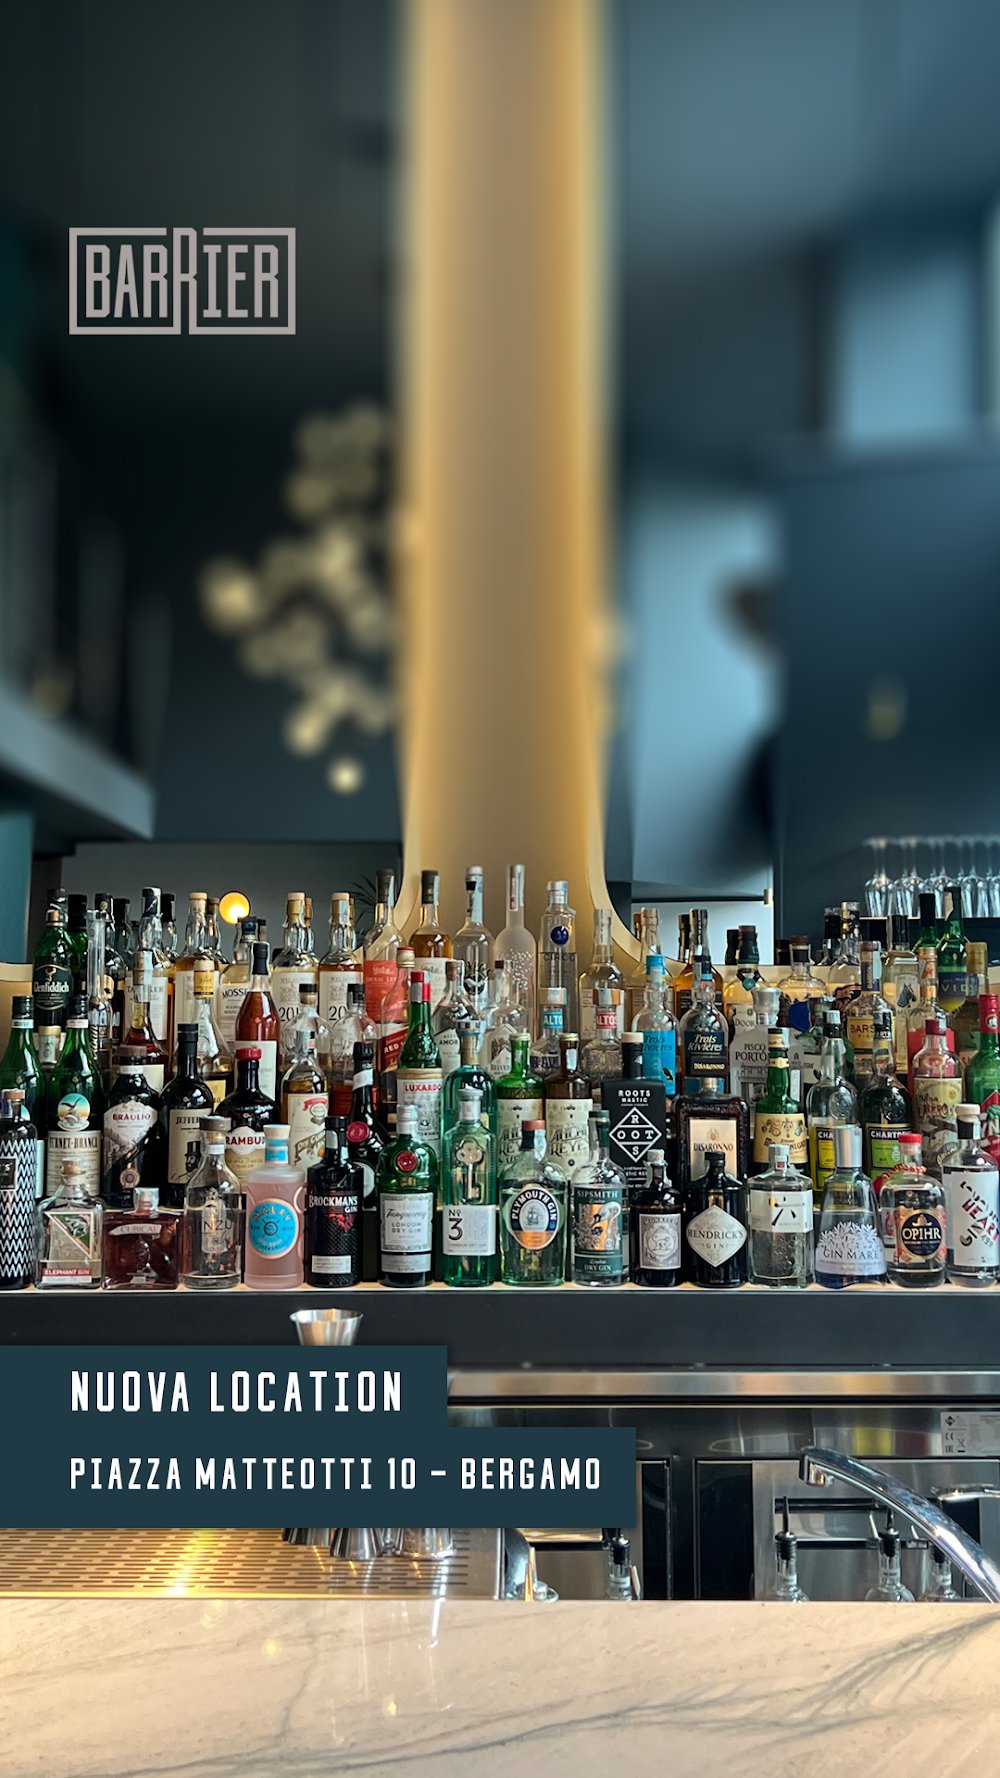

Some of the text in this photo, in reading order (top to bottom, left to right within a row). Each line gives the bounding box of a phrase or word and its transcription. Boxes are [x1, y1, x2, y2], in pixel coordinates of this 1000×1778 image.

[694, 1034, 717, 1044] Trois
[743, 1043, 766, 1051] PISCO
[693, 1062, 725, 1070] DISARONNO
[404, 1083, 443, 1092] LUXARDO
[617, 1089, 651, 1098] ROOTS
[112, 1112, 151, 1121] BRAULIO
[693, 1142, 734, 1152] DISARONNO
[577, 1190, 619, 1199] SIPSMITH
[308, 1195, 359, 1208] BROCKMANS
[511, 1189, 558, 1221] PLYMOUTH GIN
[386, 1208, 427, 1220] Tanqueray
[448, 1217, 463, 1241] 3
[688, 1228, 744, 1240] HENDRICK'S
[902, 1227, 942, 1240] OPIHR
[823, 1249, 879, 1260] GIN MARE
